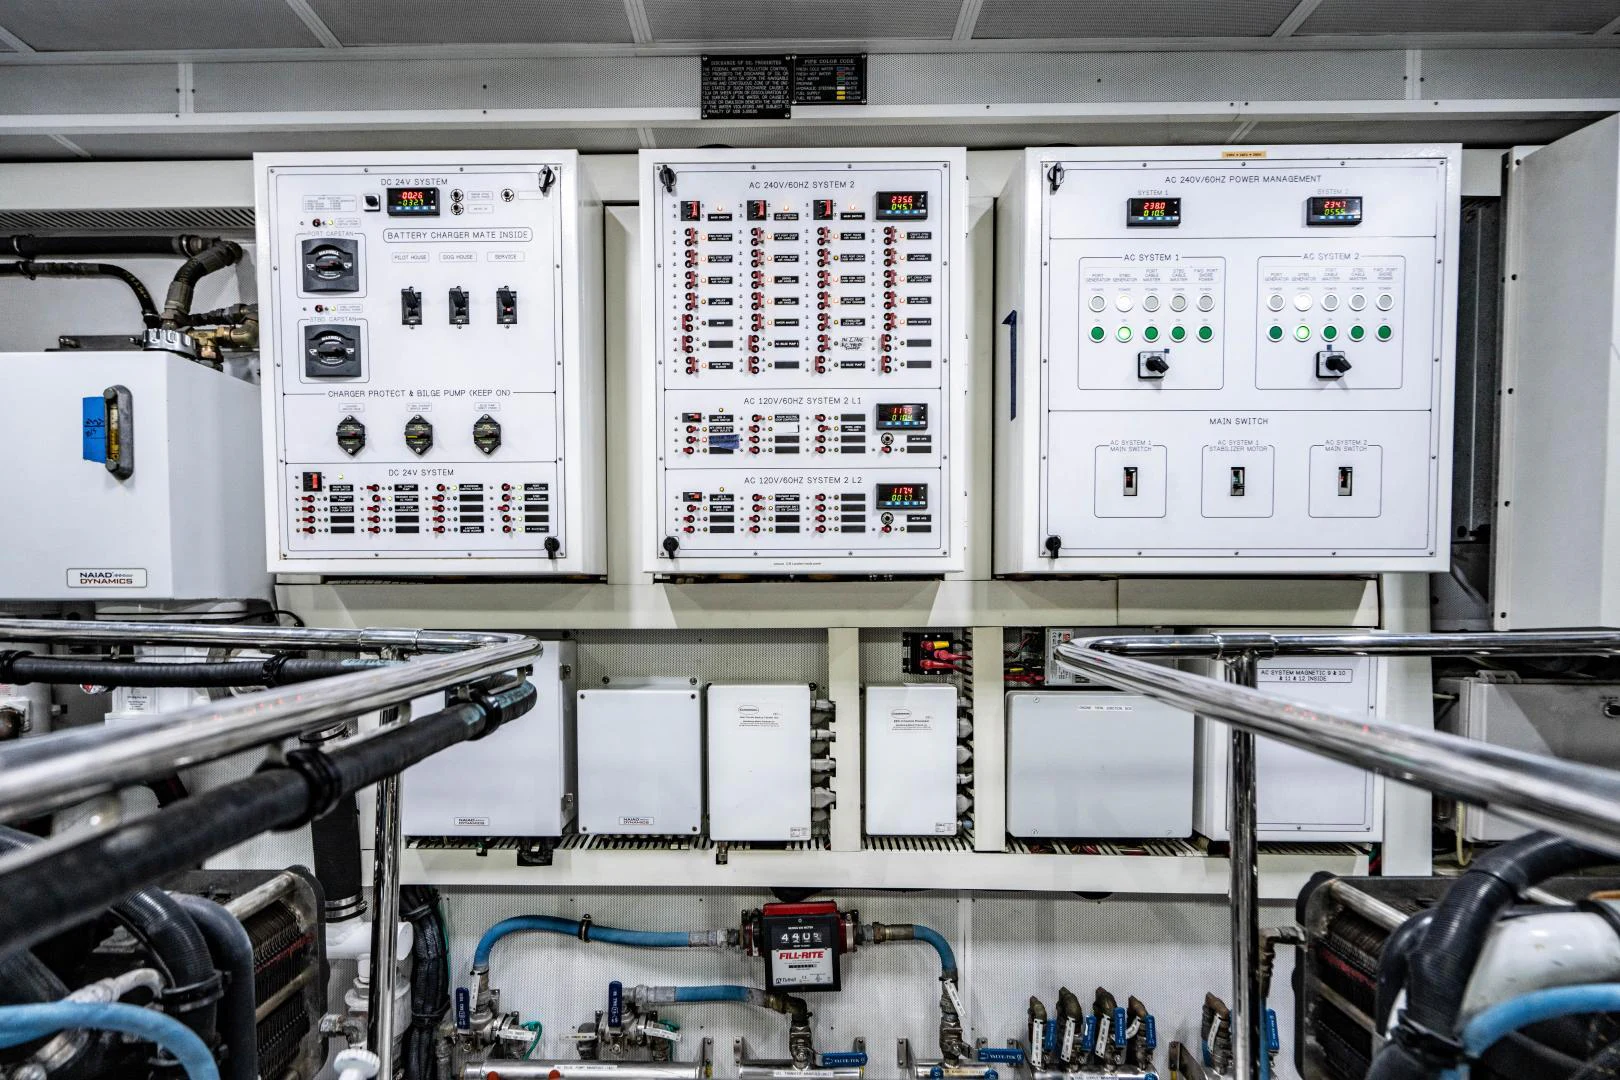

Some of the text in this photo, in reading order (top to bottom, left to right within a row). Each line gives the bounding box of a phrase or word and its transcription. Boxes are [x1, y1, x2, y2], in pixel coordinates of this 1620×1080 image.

[749, 181, 855, 189] AC 240V/60HZ SYSTEM 2
[388, 231, 428, 240] BATTERY
[431, 231, 470, 239] CHARGER
[500, 230, 528, 238] INSIDE
[744, 397, 861, 405] AC 120V/60HZ SYSTEM 2 L1
[779, 951, 824, 959] FILL-RITE
